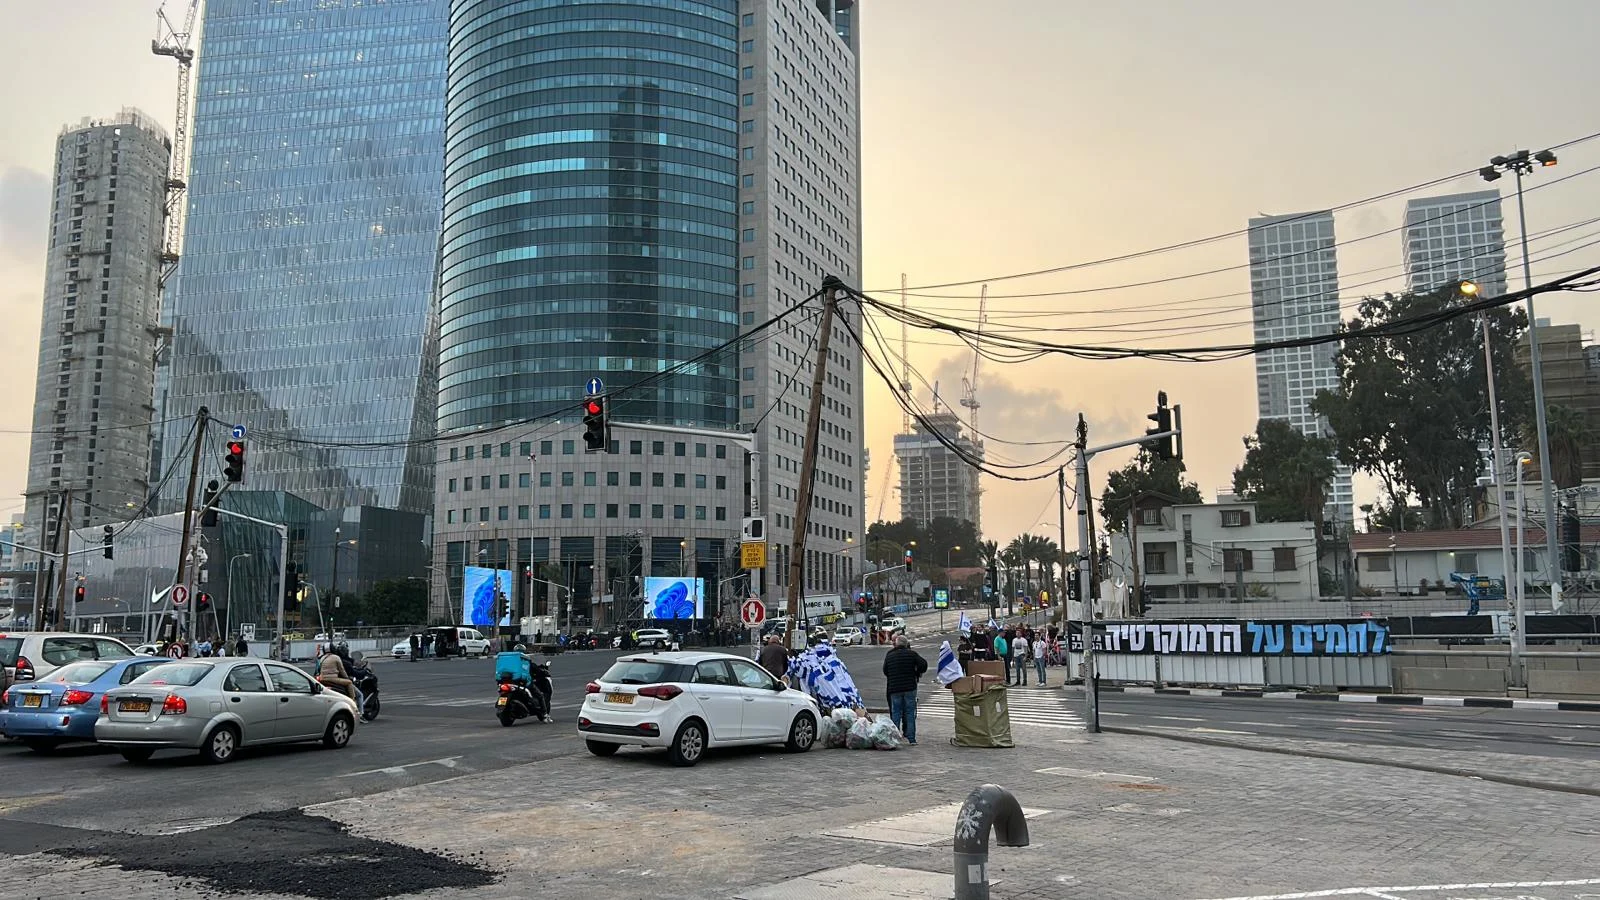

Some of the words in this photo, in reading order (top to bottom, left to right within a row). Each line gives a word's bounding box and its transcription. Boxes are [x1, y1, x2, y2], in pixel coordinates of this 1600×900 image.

[1071, 633, 1103, 642] מה
[1071, 642, 1103, 650] הבק
[1104, 624, 1242, 654] הדמוקרטיה
[1246, 621, 1285, 653] על
